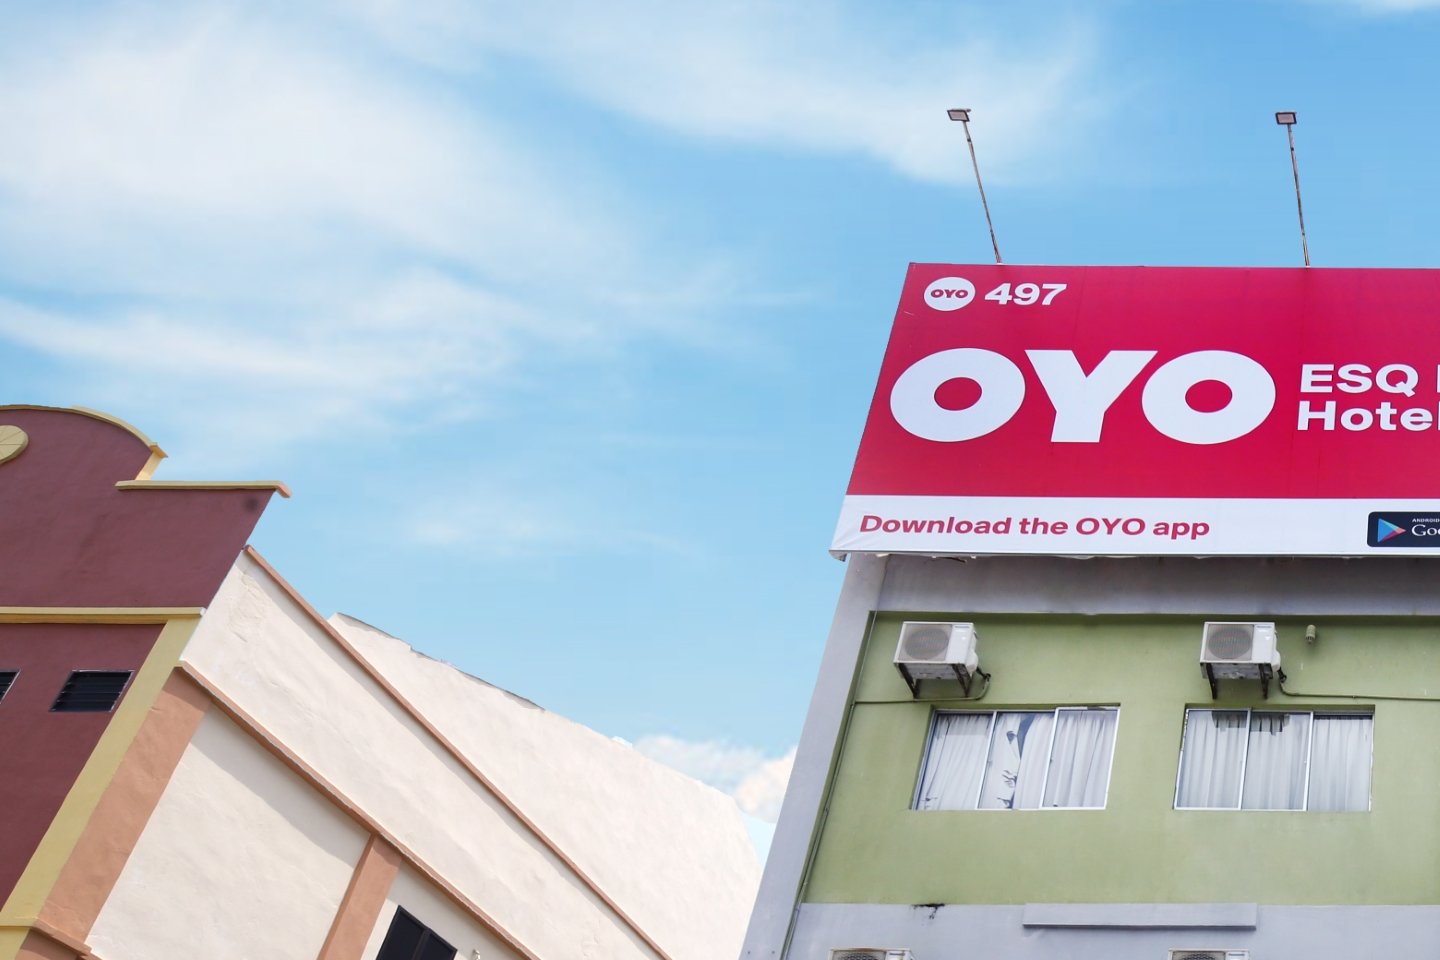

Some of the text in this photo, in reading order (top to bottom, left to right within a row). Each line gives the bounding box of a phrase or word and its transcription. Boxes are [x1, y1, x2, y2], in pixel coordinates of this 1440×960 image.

[930, 282, 1067, 306] OYO 497
[1300, 363, 1419, 397] ESQ
[889, 347, 1276, 445] OYO
[859, 515, 1210, 540] Download the OYO app
